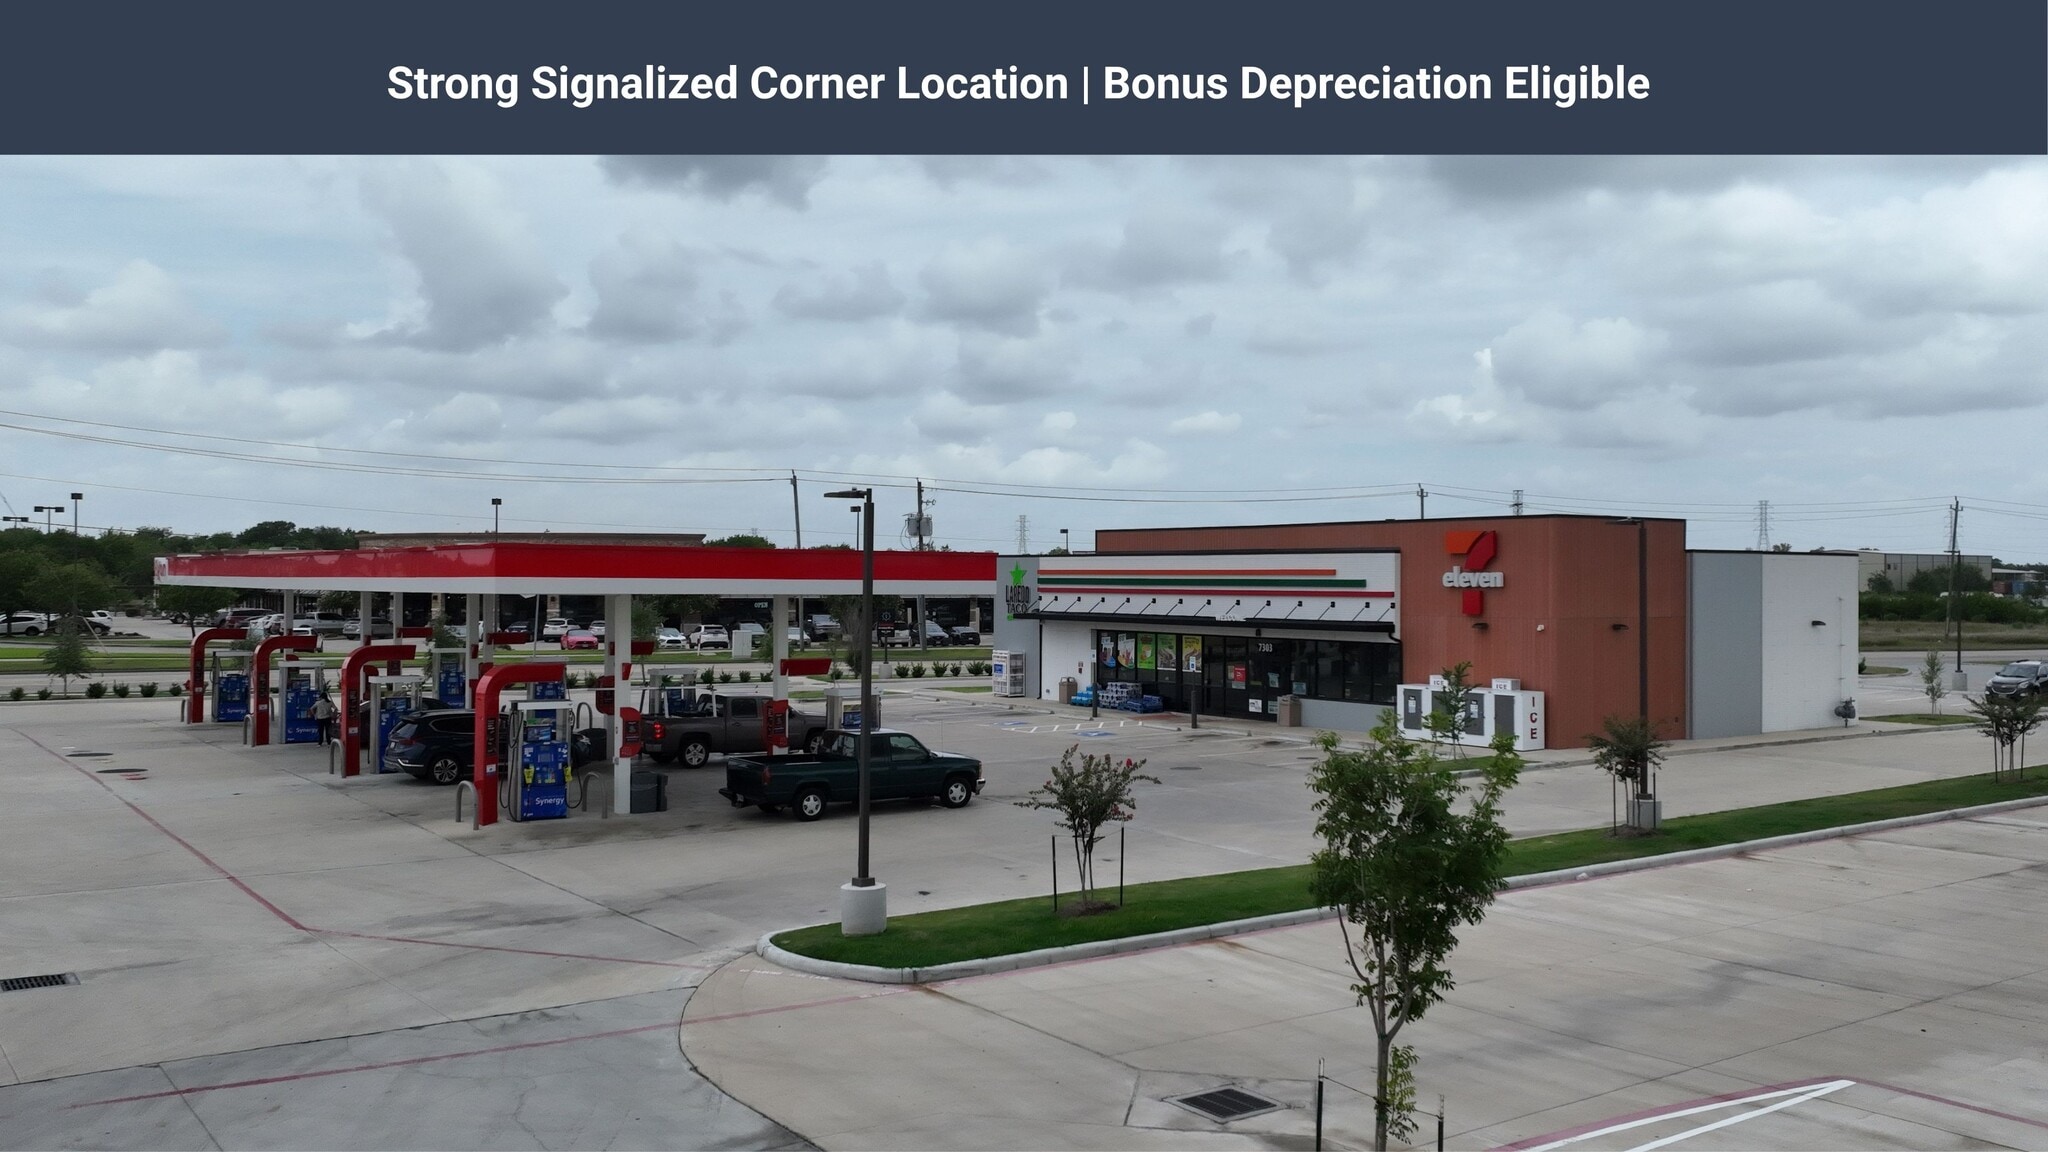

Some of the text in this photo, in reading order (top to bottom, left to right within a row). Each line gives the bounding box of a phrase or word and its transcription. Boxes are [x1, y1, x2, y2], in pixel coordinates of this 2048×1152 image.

[1442, 566, 1504, 587] eleven
[1005, 584, 1031, 604] LAREDO
[1007, 603, 1028, 613] TACO
[1258, 643, 1273, 652] 7303
[1530, 696, 1538, 739] ICE
[296, 727, 318, 735] Synergy
[535, 797, 565, 806] Synergy
